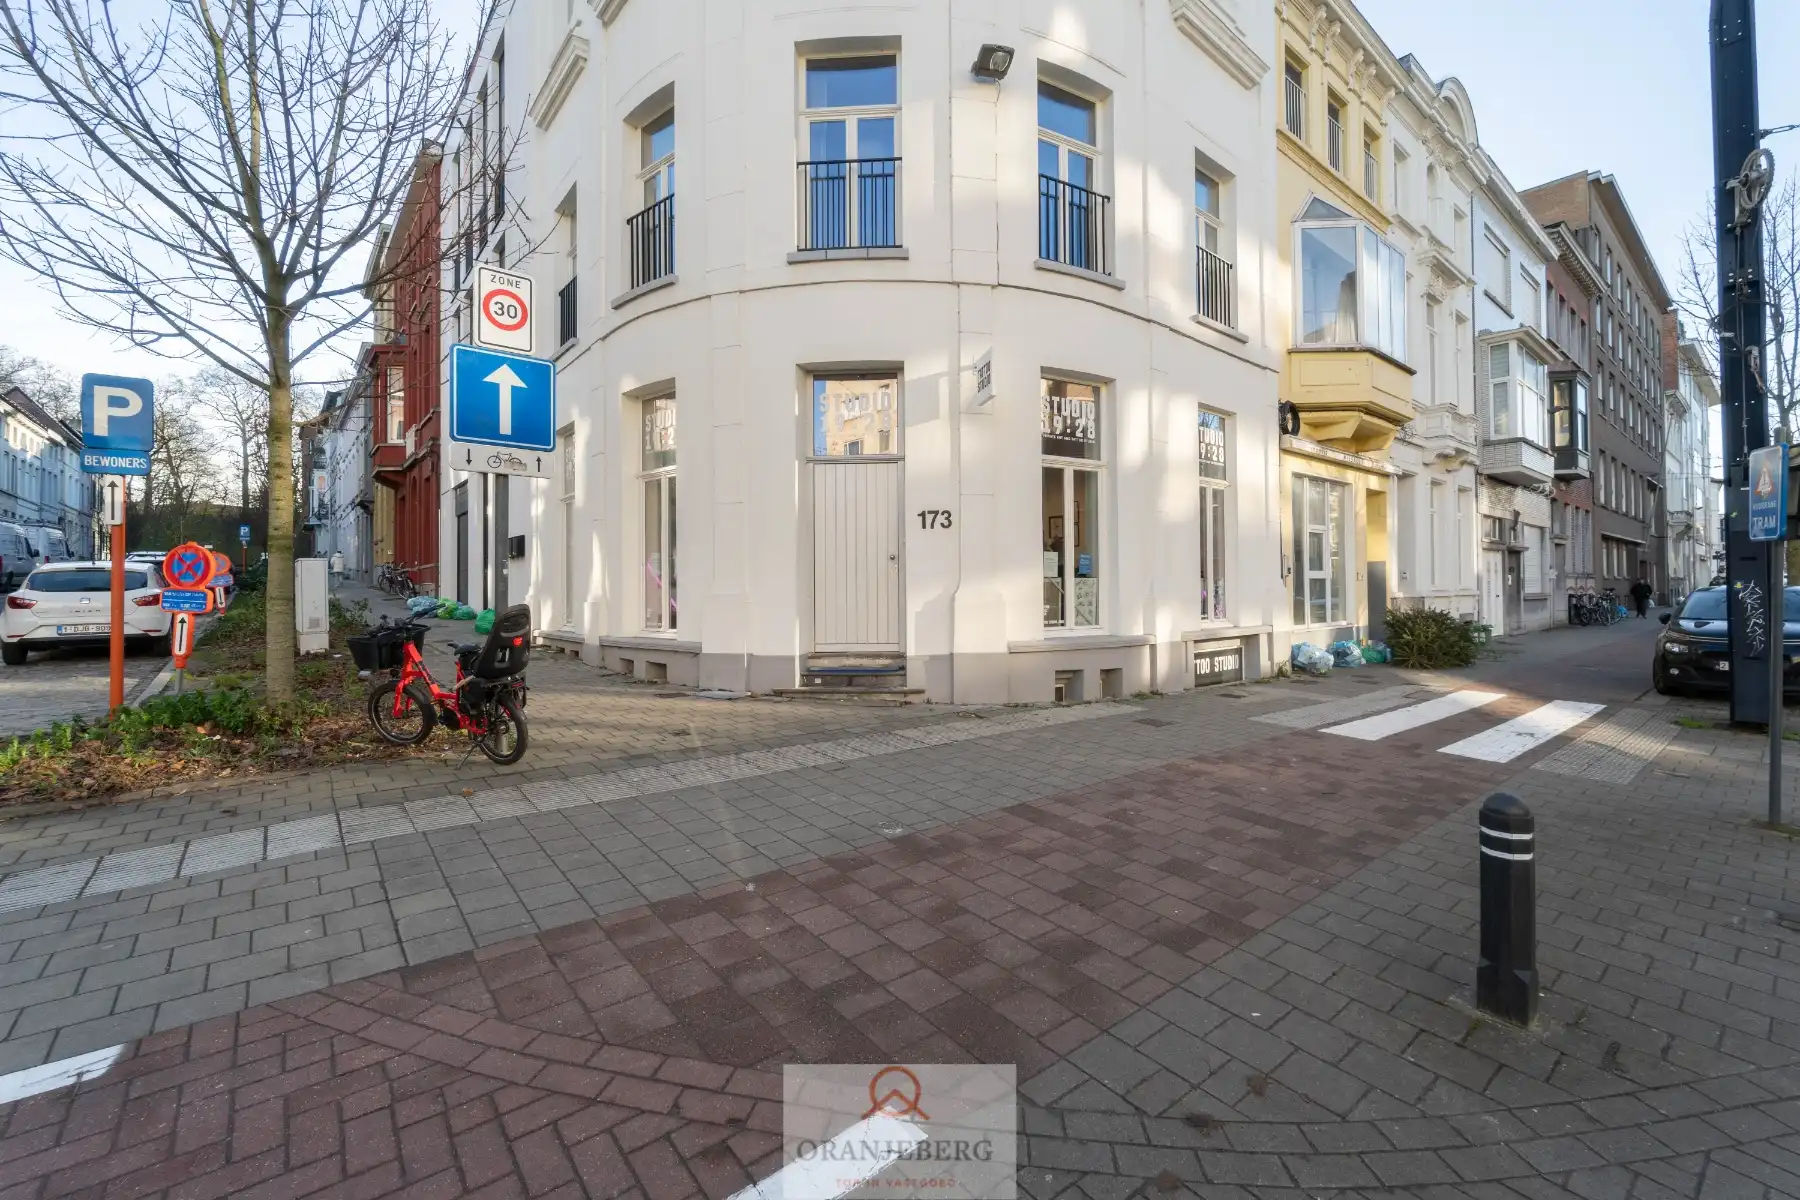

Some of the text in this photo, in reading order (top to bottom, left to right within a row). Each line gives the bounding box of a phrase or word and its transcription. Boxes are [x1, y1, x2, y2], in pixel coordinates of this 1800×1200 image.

[491, 274, 521, 289] ZONE
[494, 301, 518, 319] 30
[93, 385, 143, 436] P
[819, 392, 892, 413] STUDIO
[1041, 395, 1096, 420] STUDIO
[84, 455, 147, 469] BEWONERS
[917, 510, 953, 530] 173
[1753, 515, 1776, 531] TRAM
[241, 527, 249, 536] P
[1194, 654, 1240, 675] TOO STUDIO
